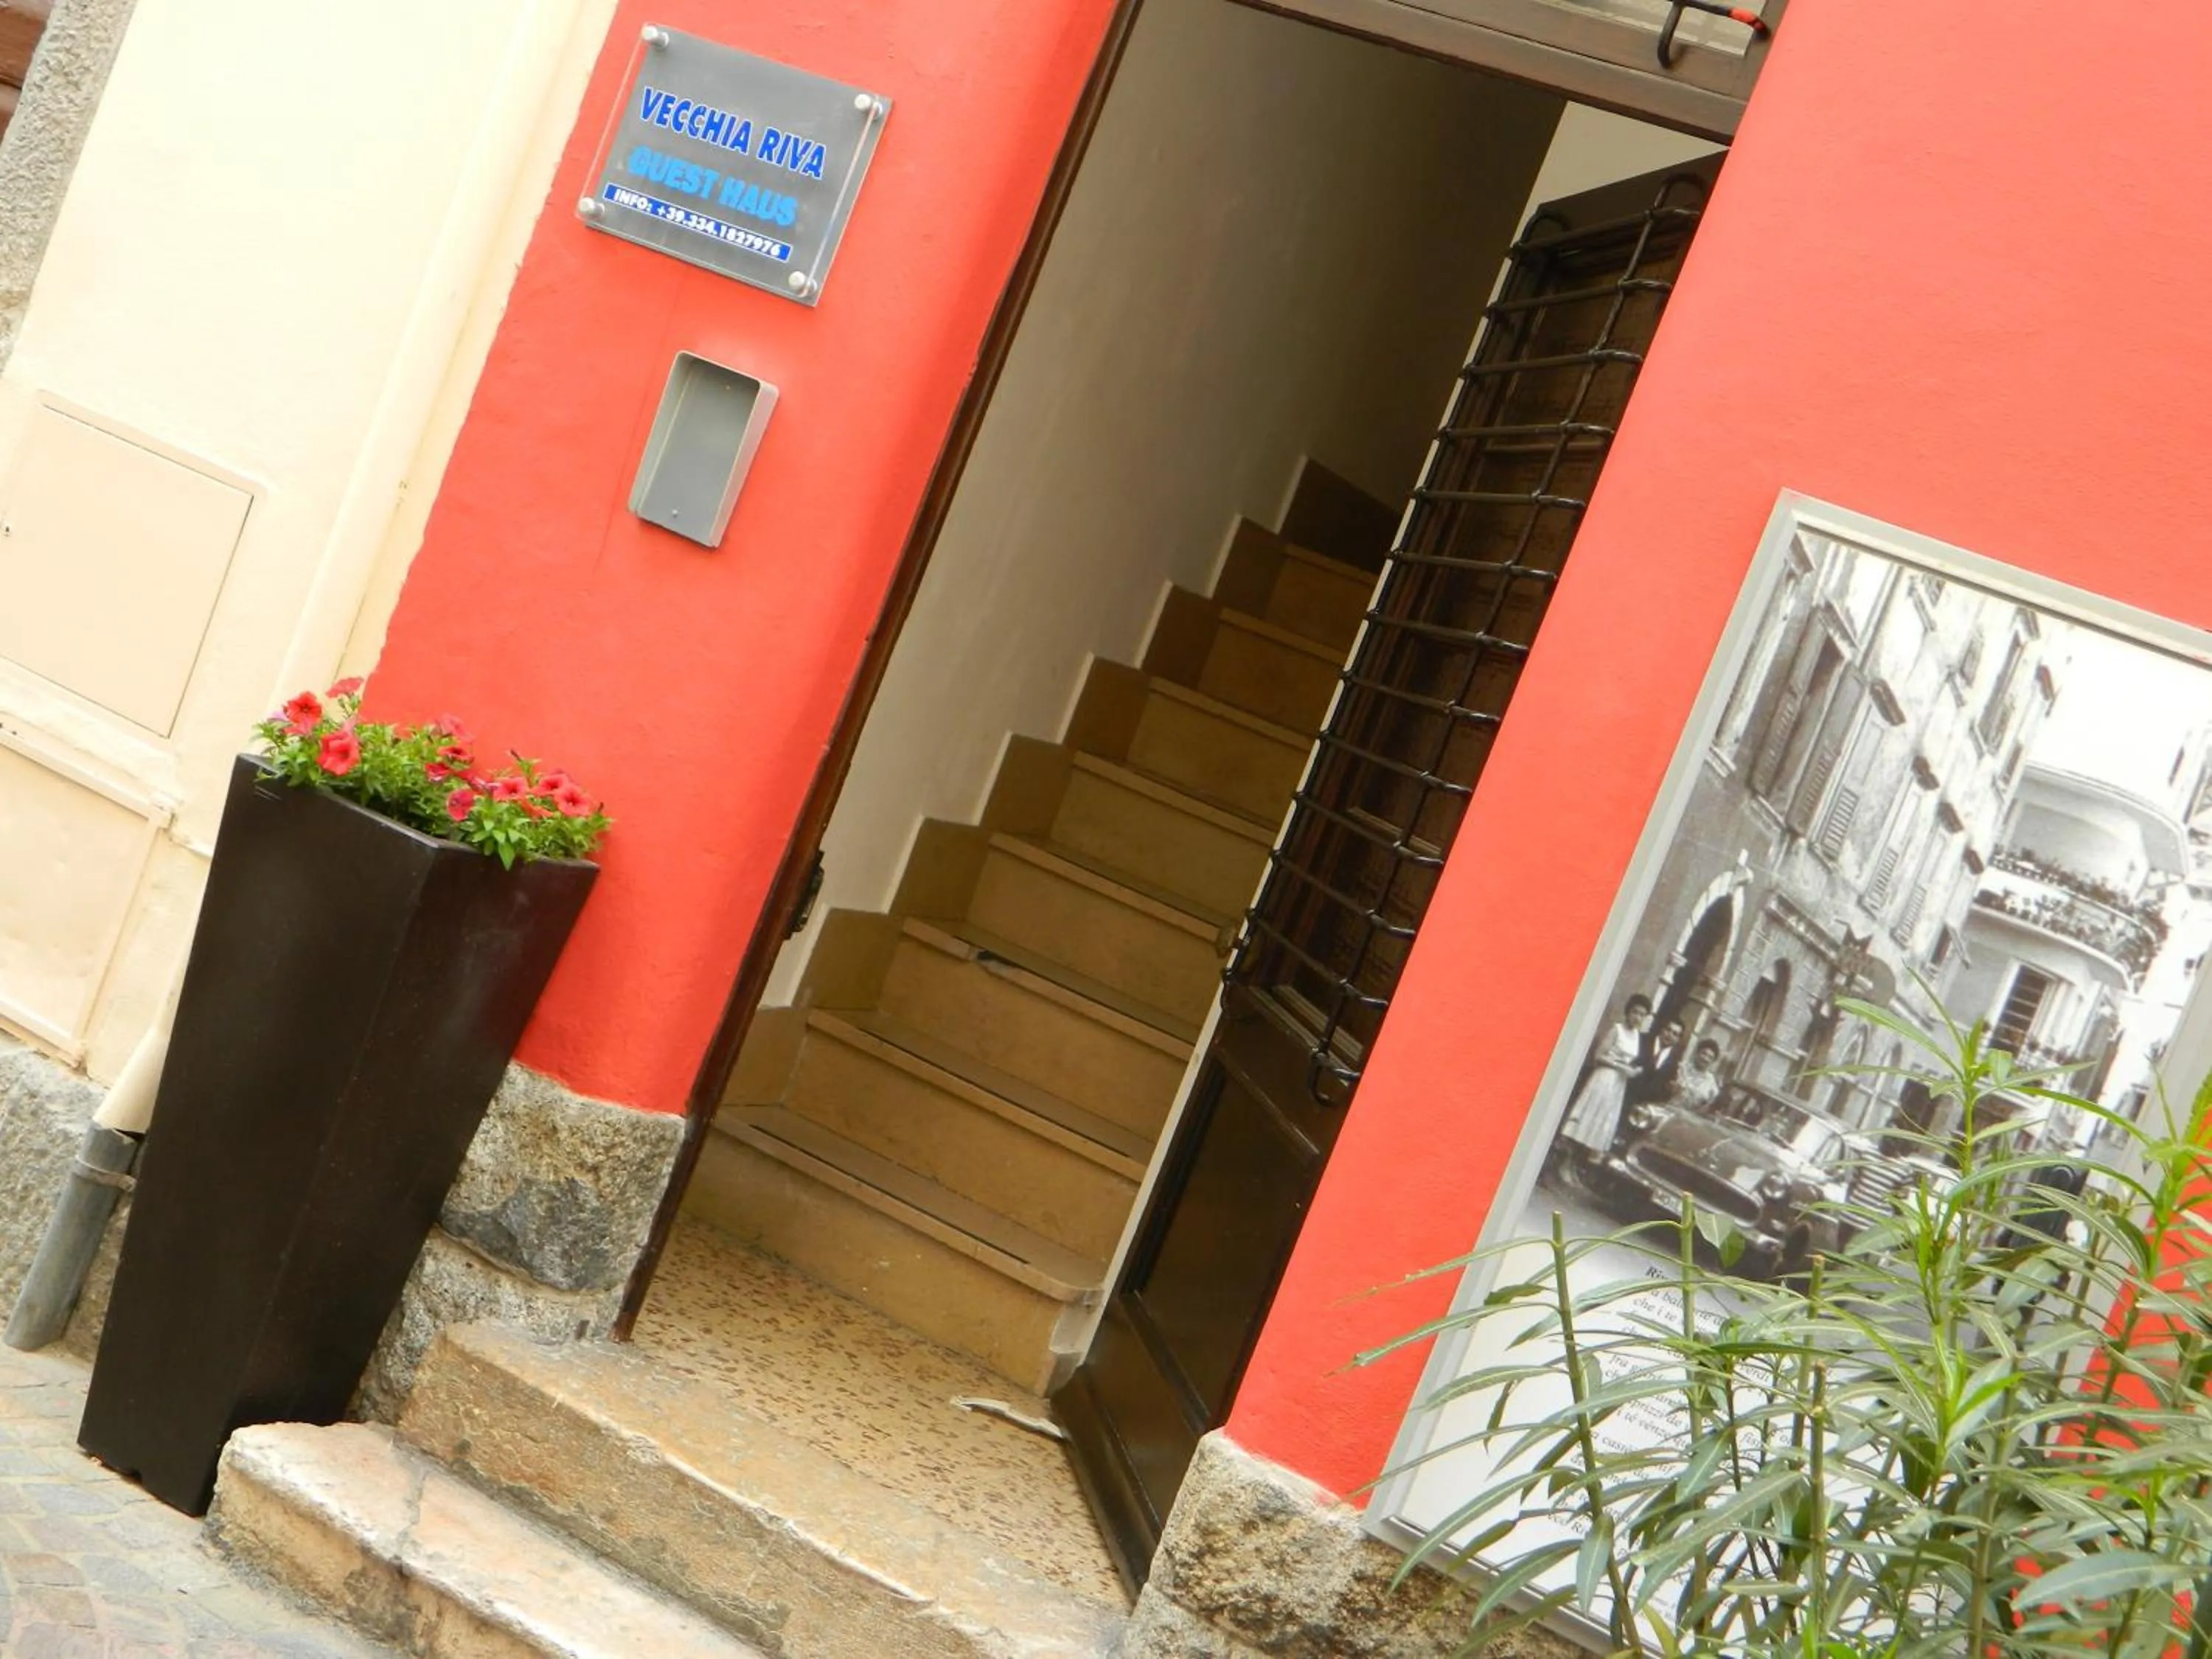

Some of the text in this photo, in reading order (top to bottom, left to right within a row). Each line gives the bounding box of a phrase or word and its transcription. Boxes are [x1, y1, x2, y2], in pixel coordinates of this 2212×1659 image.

[640, 87, 826, 178] VECCHIA RIVA
[613, 189, 652, 212] INFO:
[629, 146, 798, 226] GUEST HAUS
